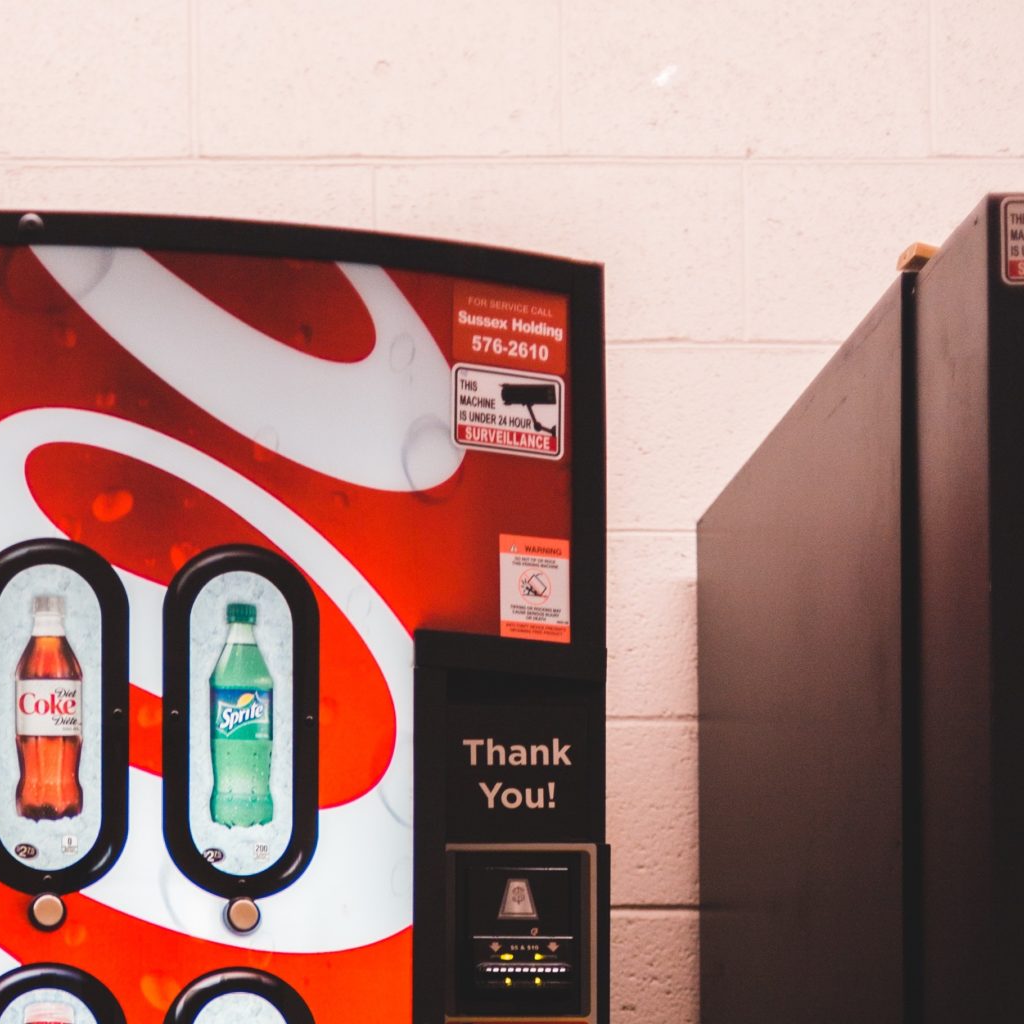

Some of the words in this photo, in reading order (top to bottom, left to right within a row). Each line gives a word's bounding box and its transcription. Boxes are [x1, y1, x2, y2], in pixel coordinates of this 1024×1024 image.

[468, 296, 487, 307] FOR
[489, 299, 528, 313] SERVICE
[530, 306, 553, 318] CALL
[458, 310, 507, 329] Sussex
[512, 318, 563, 341] Holding
[472, 335, 549, 361] 576-2610
[460, 379, 478, 392] THIS
[460, 395, 496, 409] MACHINE
[459, 410, 467, 421] IS
[469, 412, 496, 425] UNDER
[498, 415, 508, 426] 24
[509, 416, 532, 429] HOUR
[465, 427, 551, 450] SURVEILLANCE
[524, 545, 562, 556] WARNING
[19, 692, 77, 715] Coke
[219, 702, 264, 730] Sprite
[462, 738, 572, 766] Thank
[478, 782, 556, 809] You!
